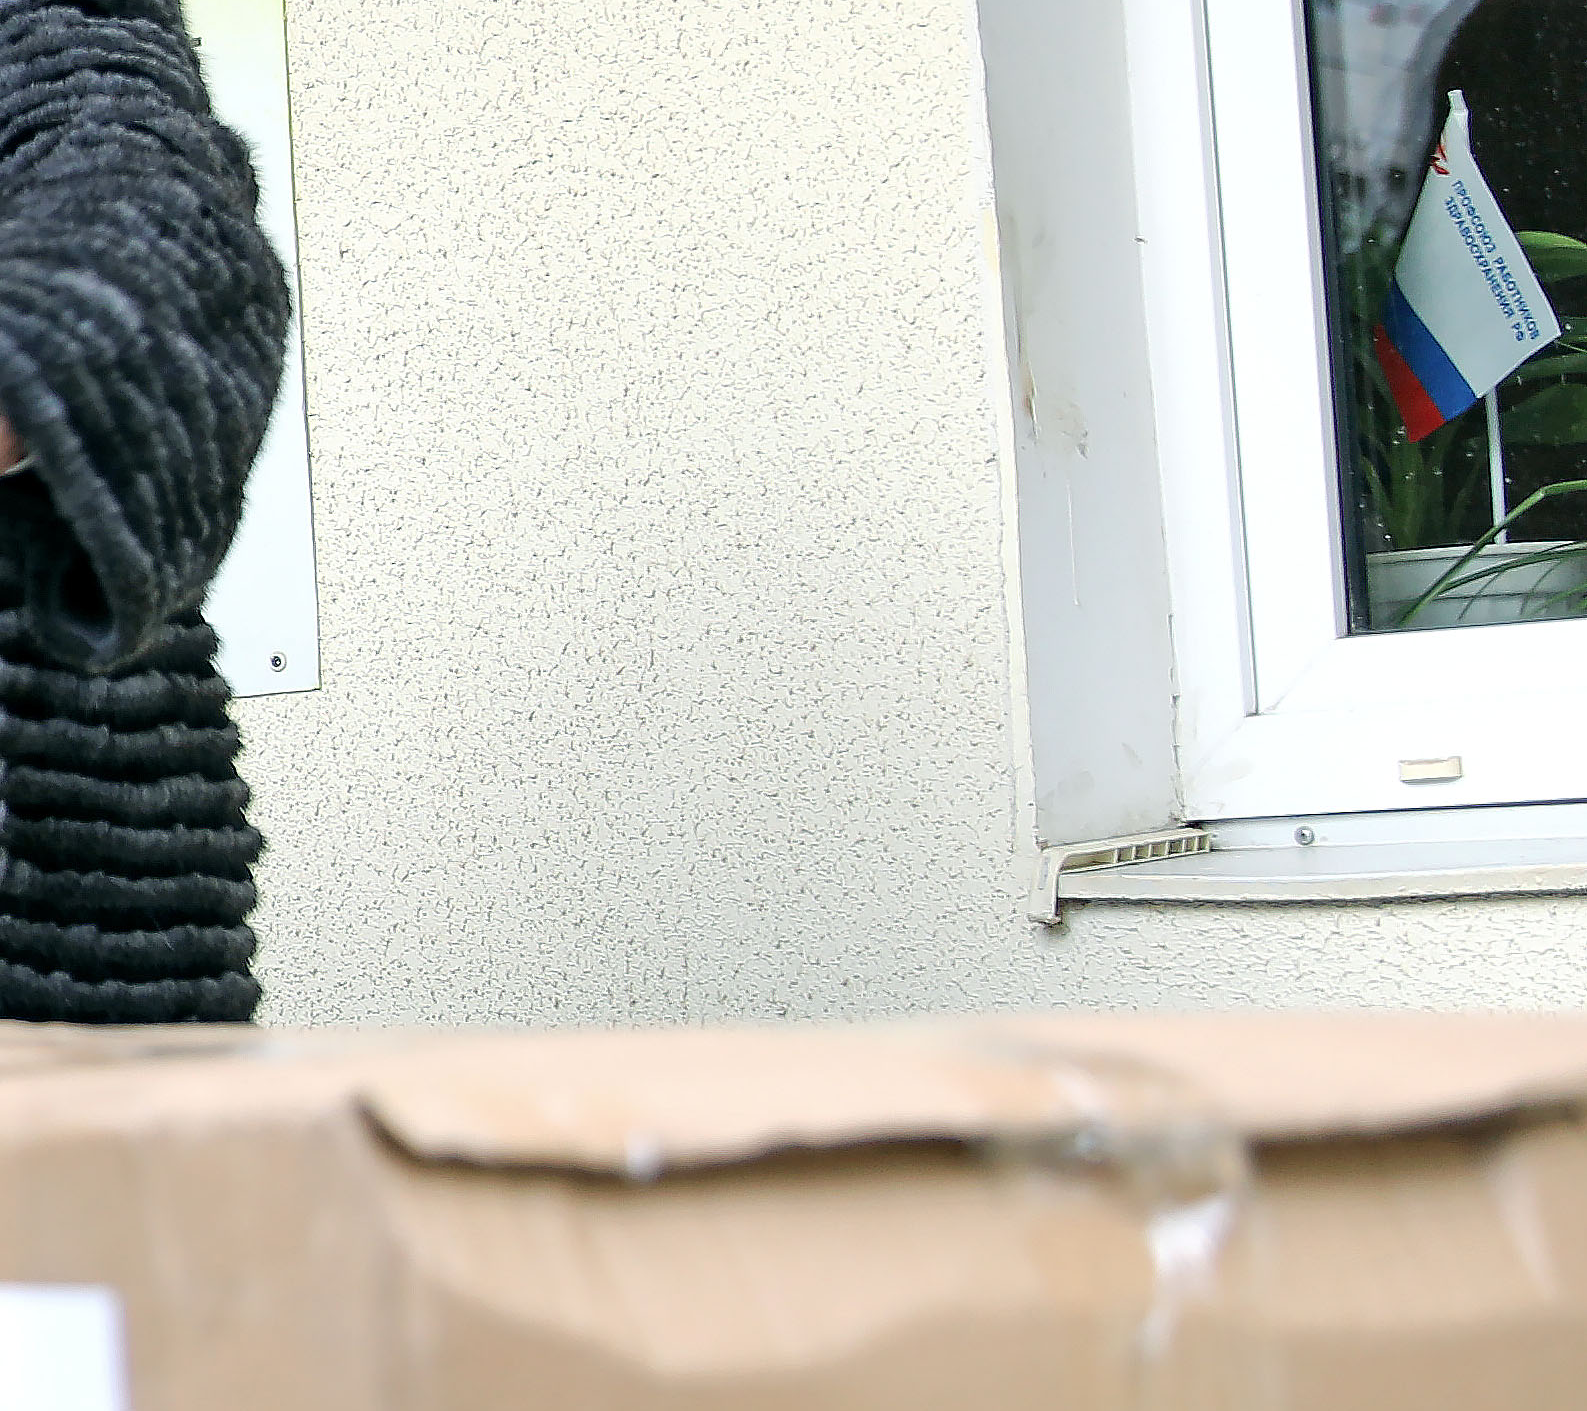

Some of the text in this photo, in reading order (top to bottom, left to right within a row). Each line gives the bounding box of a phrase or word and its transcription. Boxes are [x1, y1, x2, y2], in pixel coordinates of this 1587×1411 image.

[1452, 180, 1539, 340] ПРОФСОЮЗ РАБОТНИКОВ
[1511, 322, 1525, 341] РФ
